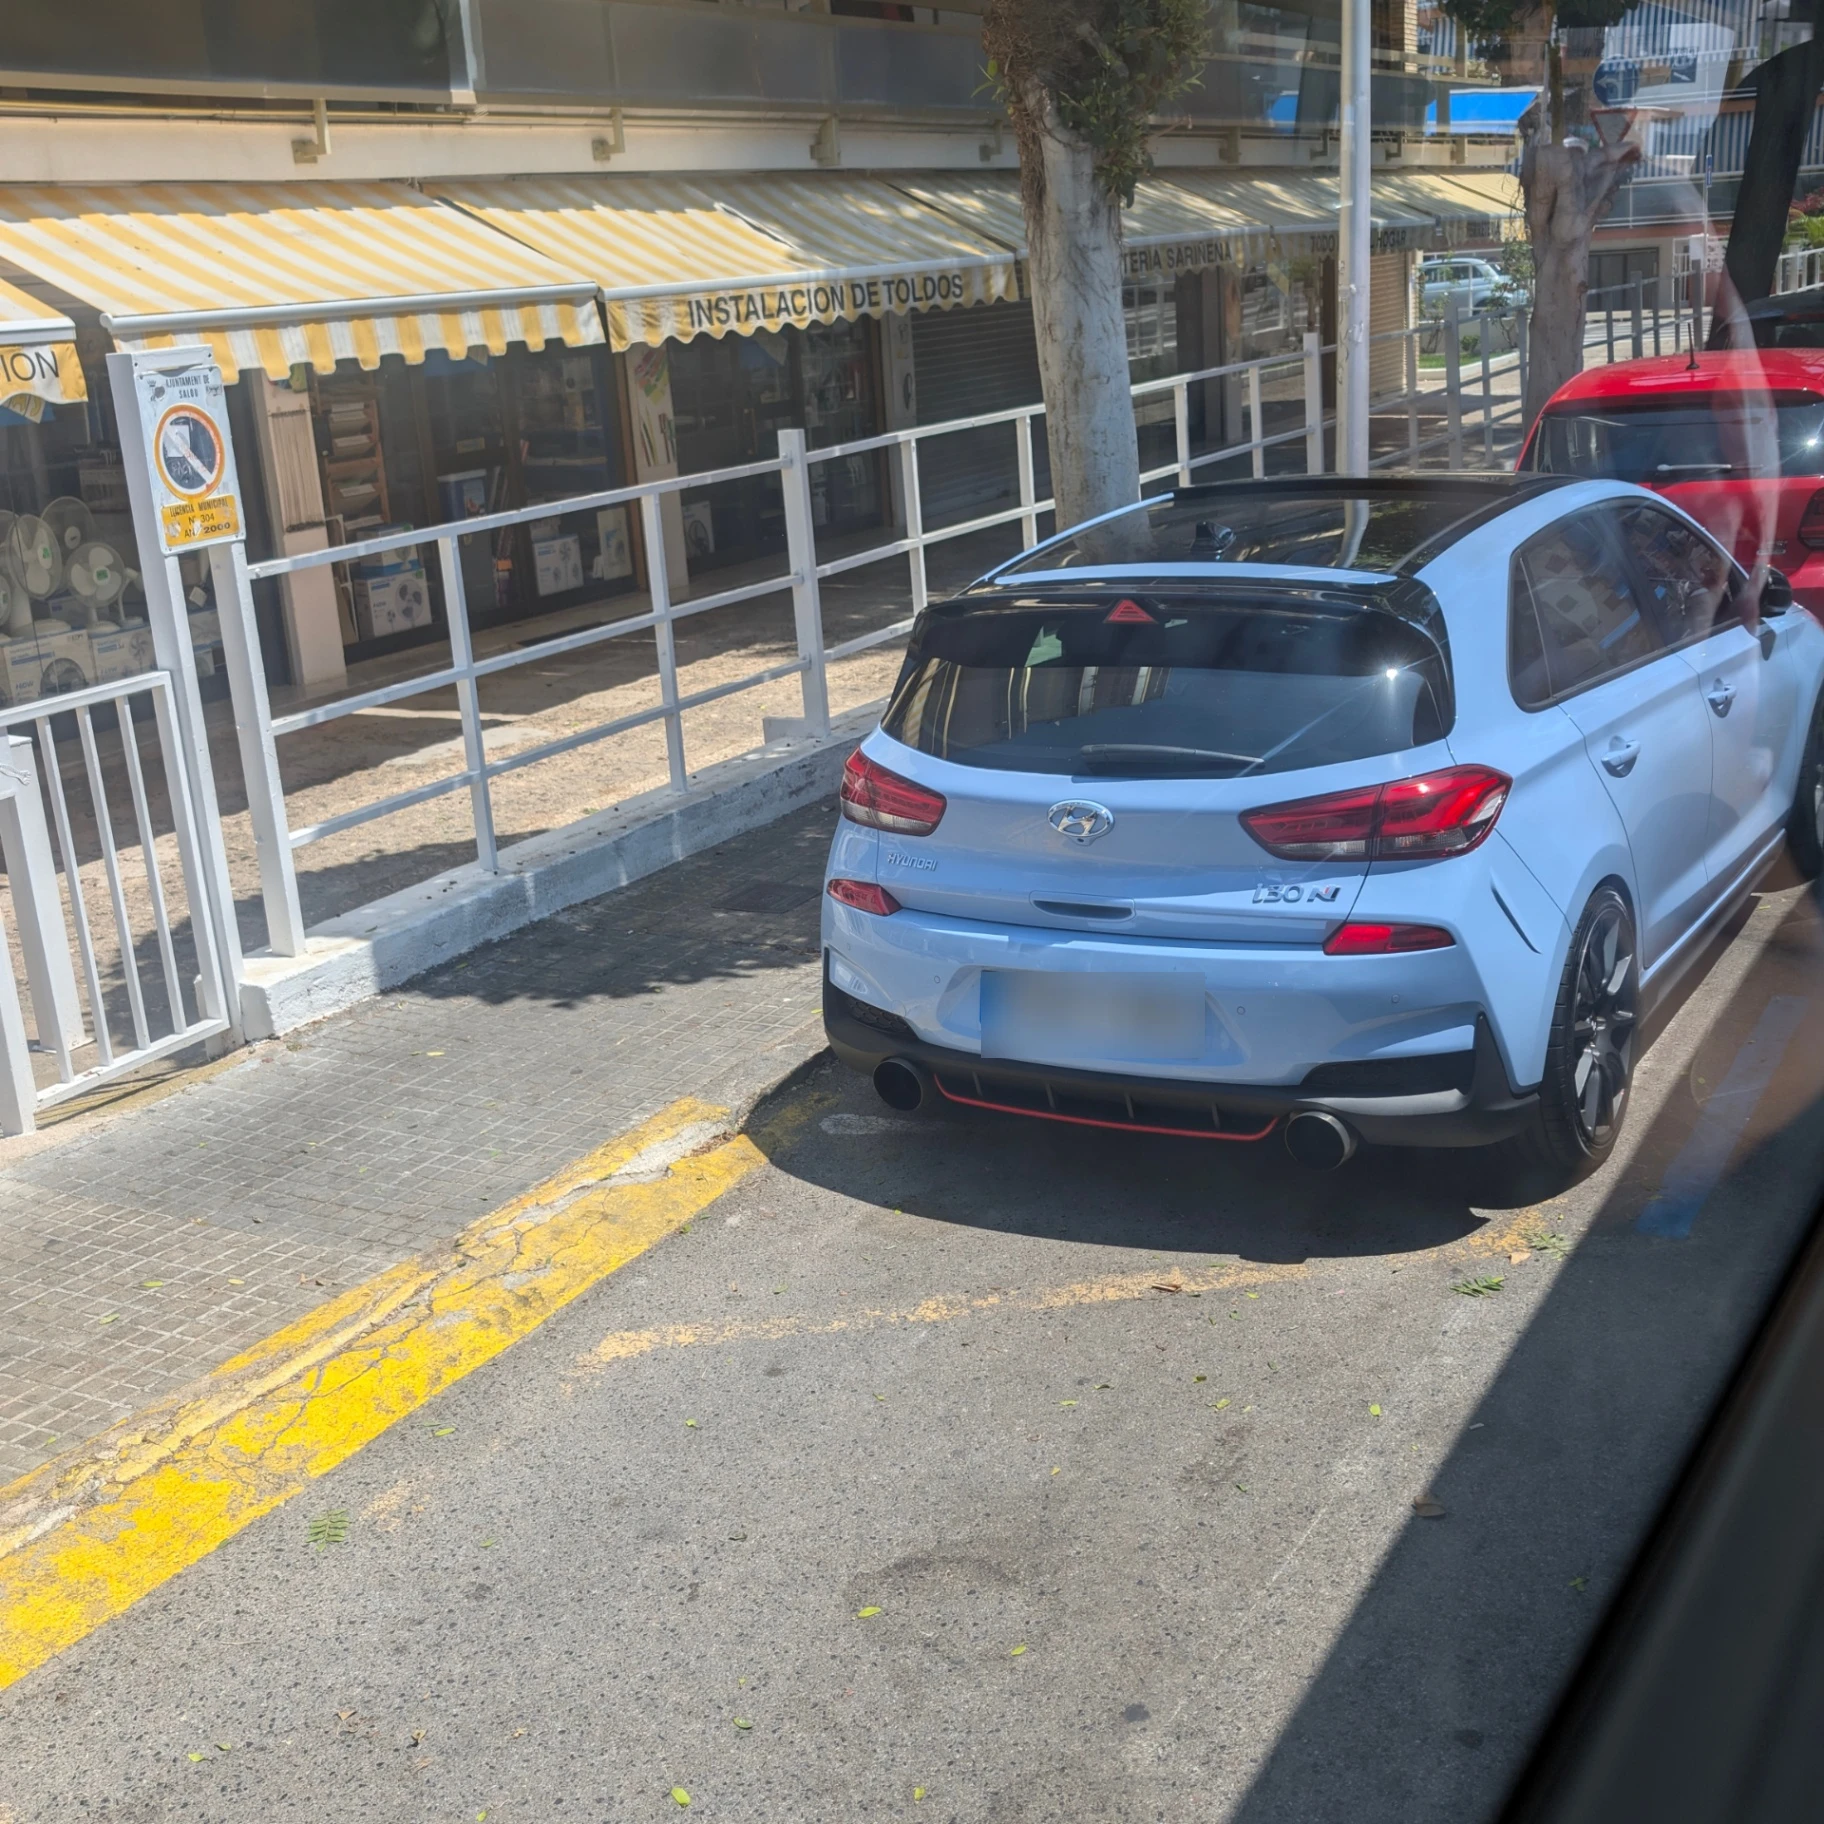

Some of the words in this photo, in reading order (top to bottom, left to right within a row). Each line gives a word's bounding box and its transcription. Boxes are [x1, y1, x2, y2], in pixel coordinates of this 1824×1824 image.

[688, 285, 845, 328] INSTALACION
[851, 281, 880, 309] DE
[883, 274, 963, 305] TOLDOS
[203, 374, 210, 384] DE
[178, 388, 198, 399] SALOU
[198, 498, 228, 511] MUNICIPAL
[200, 513, 215, 523] 304
[203, 522, 231, 534] 2000
[888, 853, 938, 871] HYUNDAI
[1252, 883, 1304, 904] i30
[1306, 885, 1341, 903] N
